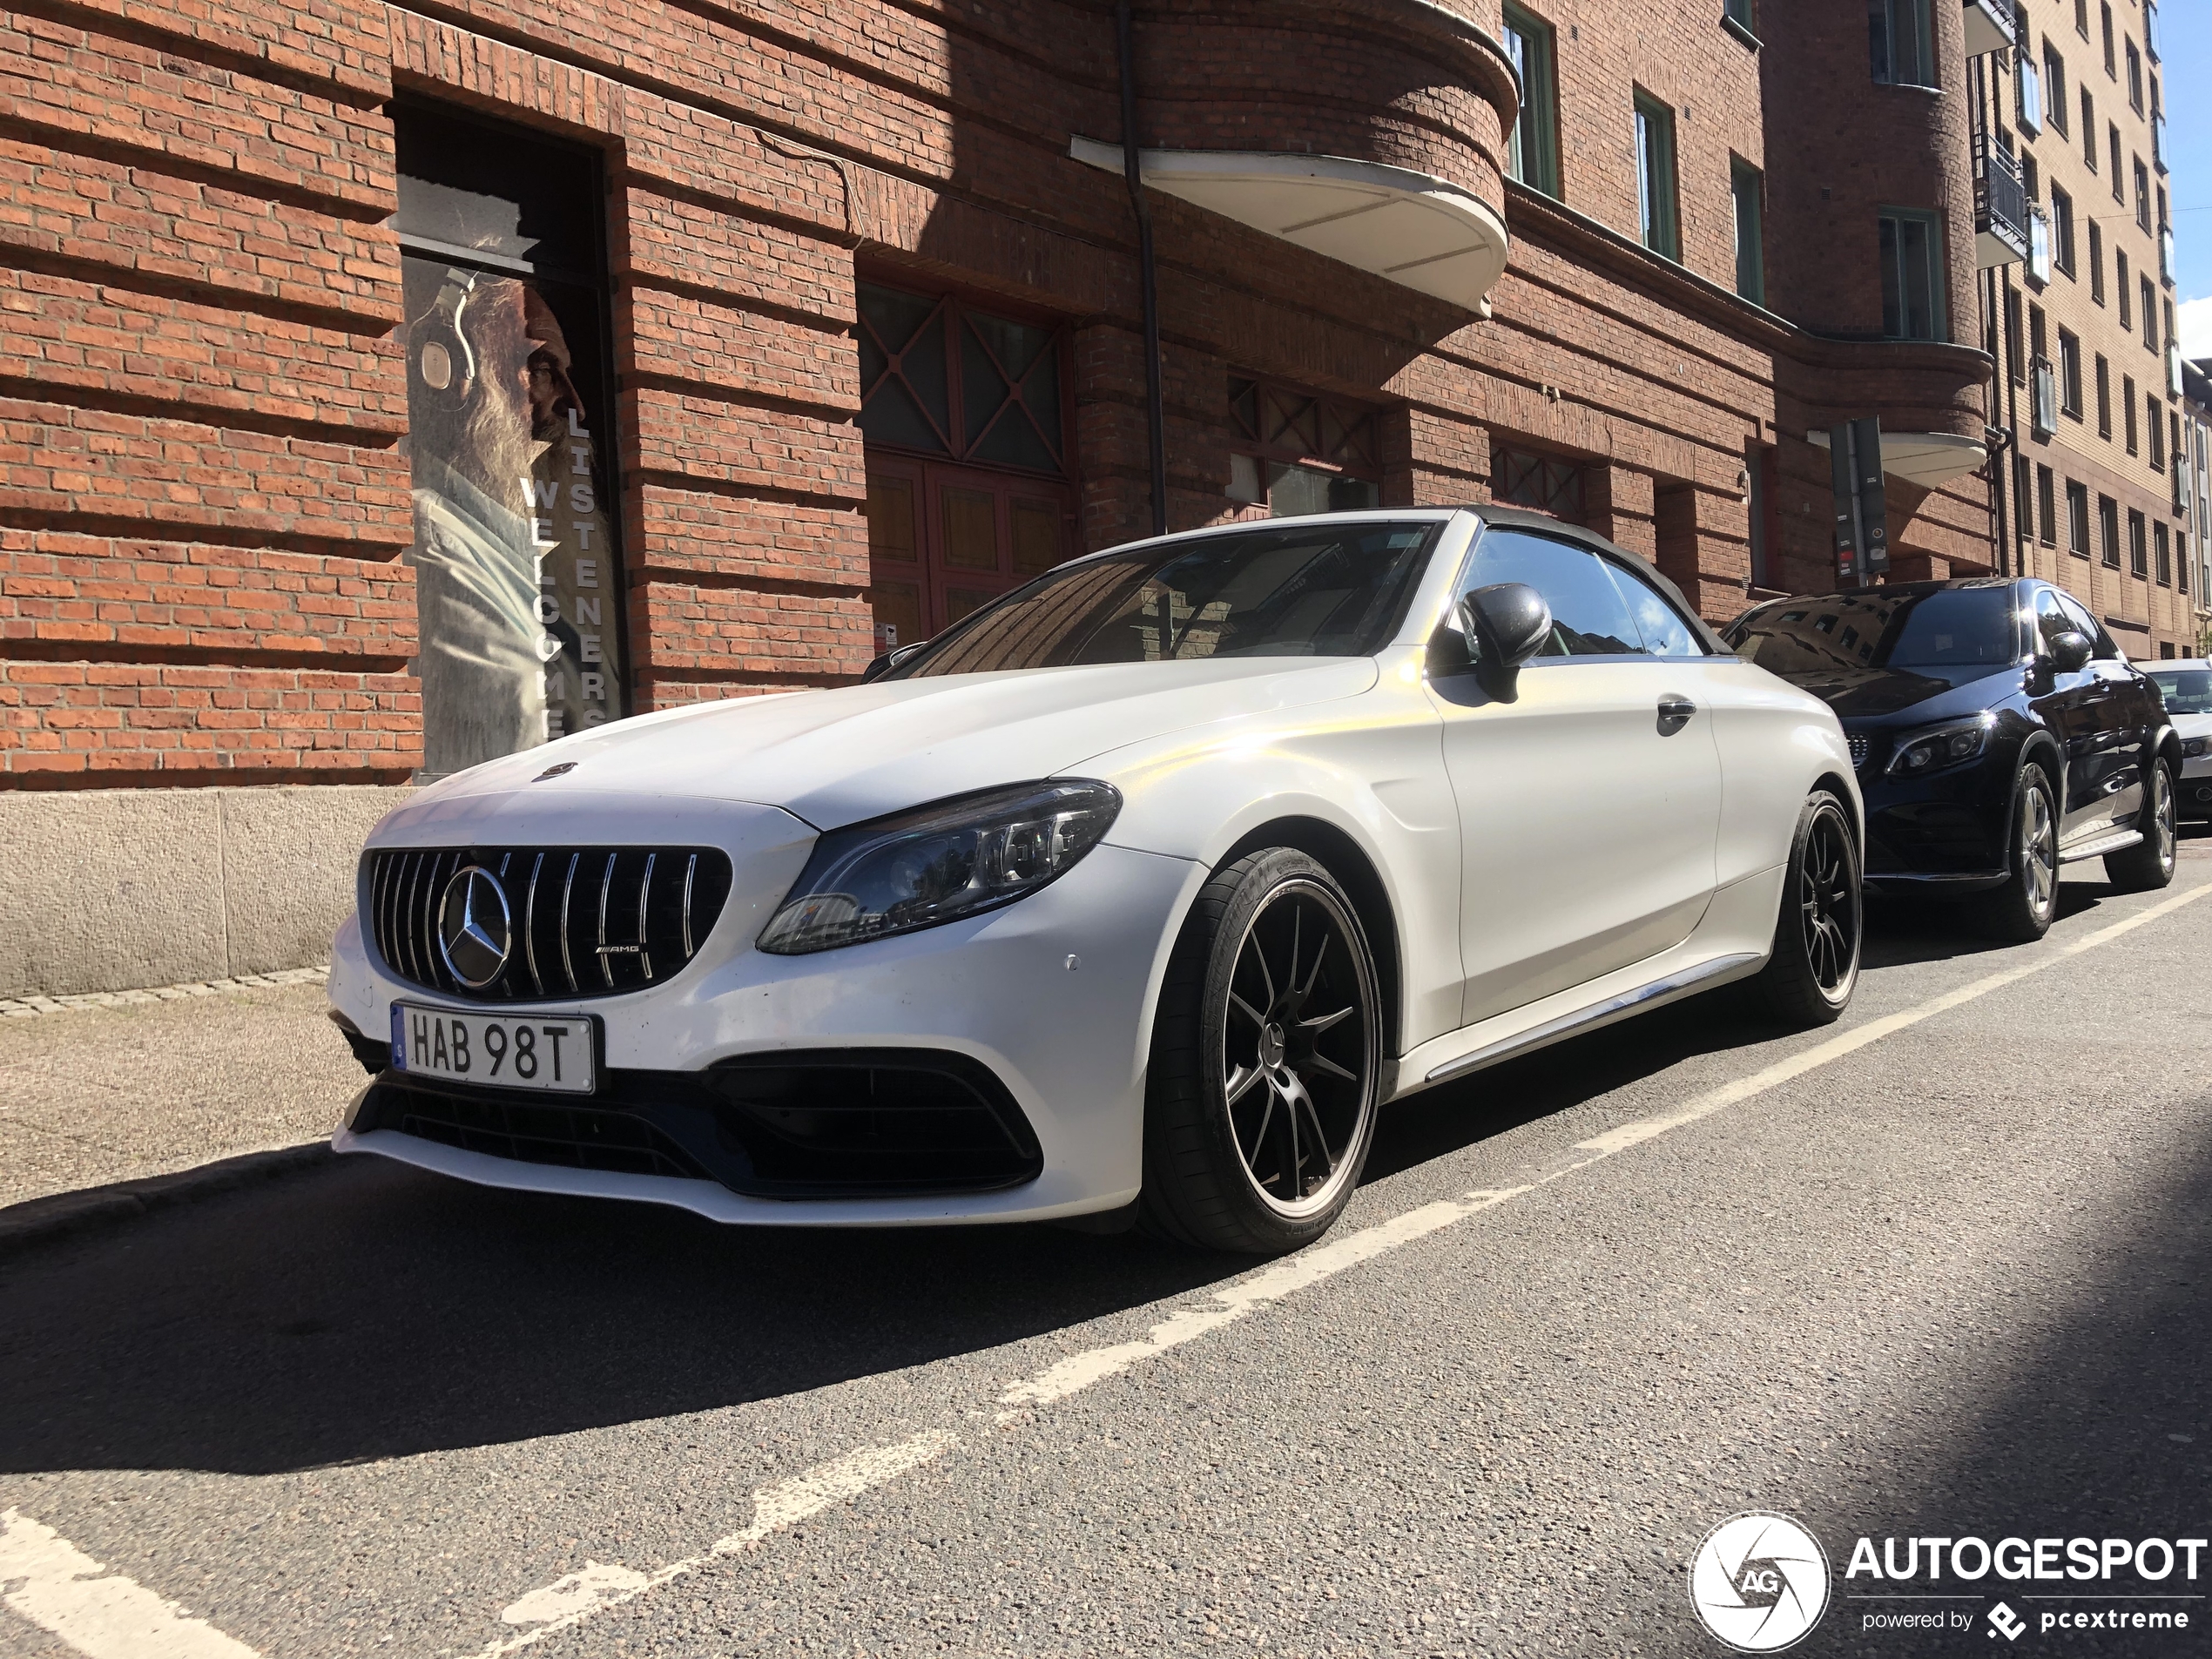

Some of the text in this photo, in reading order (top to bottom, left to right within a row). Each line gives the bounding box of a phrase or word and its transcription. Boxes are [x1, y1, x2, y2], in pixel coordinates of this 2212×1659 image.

[520, 476, 565, 738] WELCOME
[568, 408, 607, 728] LISTENERS
[413, 1014, 568, 1082] HAB 98T
